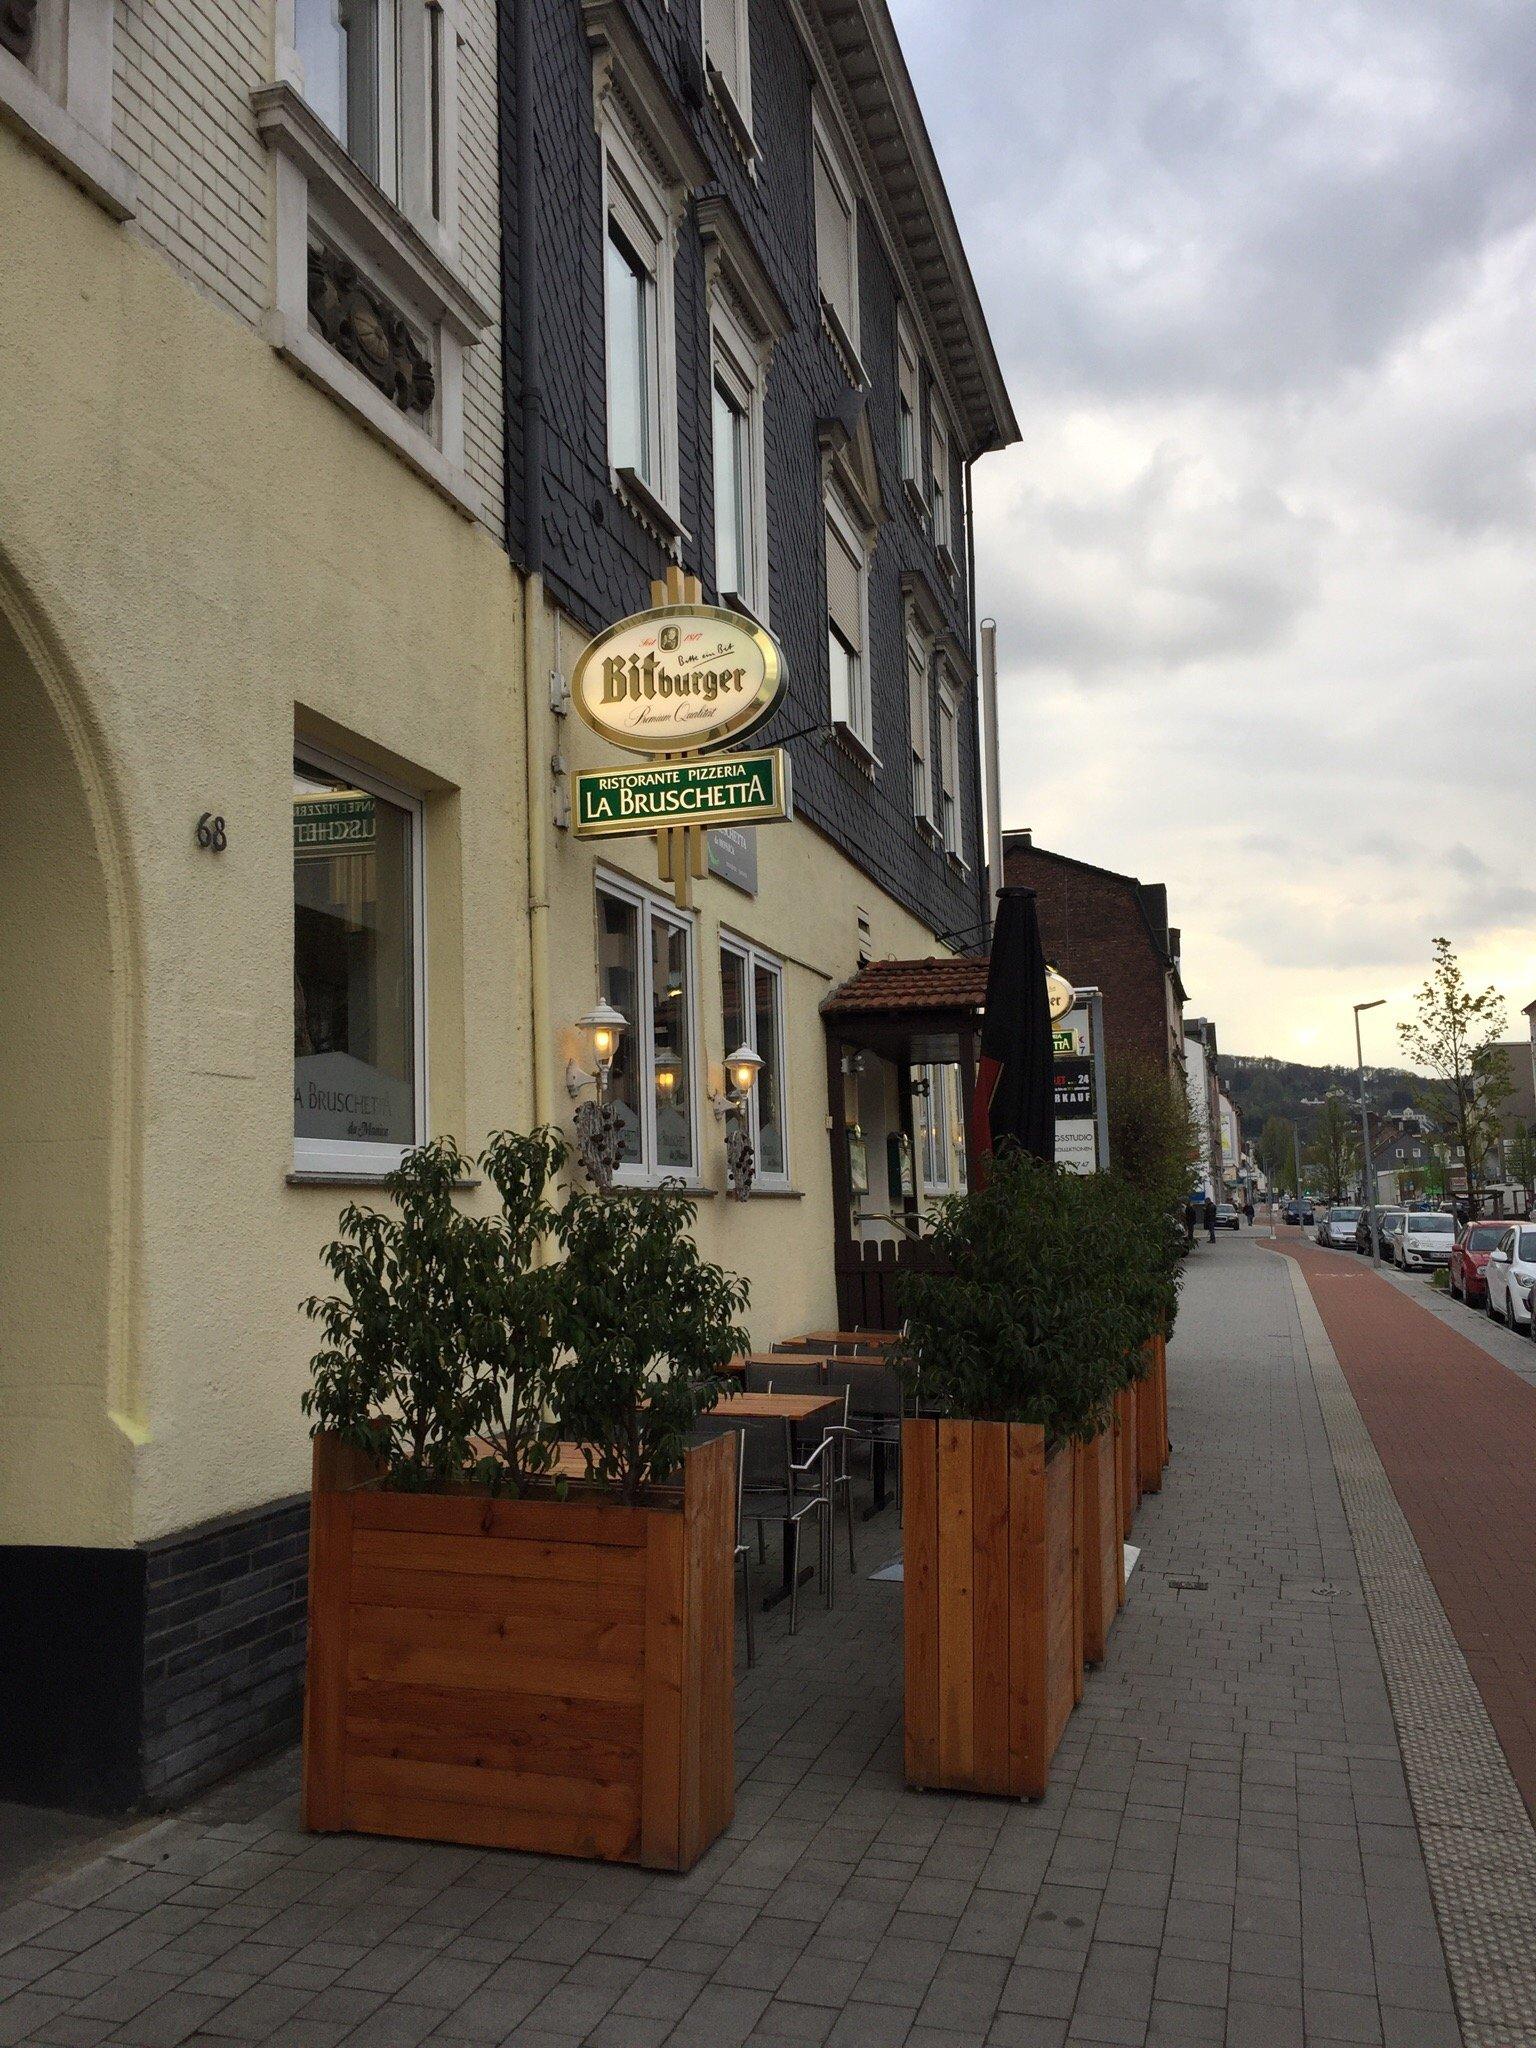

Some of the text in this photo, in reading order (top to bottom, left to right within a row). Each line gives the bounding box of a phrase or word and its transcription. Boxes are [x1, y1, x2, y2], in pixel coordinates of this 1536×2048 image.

[677, 654, 699, 667] Bitte
[717, 643, 735, 654] Bit
[600, 651, 747, 704] Bitburger
[624, 705, 672, 728] Premium
[599, 764, 747, 790] RISTORANTE PIZZERIA
[586, 774, 766, 819] LA BRUSCHETTA
[197, 812, 227, 851] 68
[1050, 997, 1061, 1007] er
[1053, 1038, 1070, 1050] TTA
[294, 1086, 304, 1109] A
[1054, 1133, 1093, 1142] GSSTUDIO
